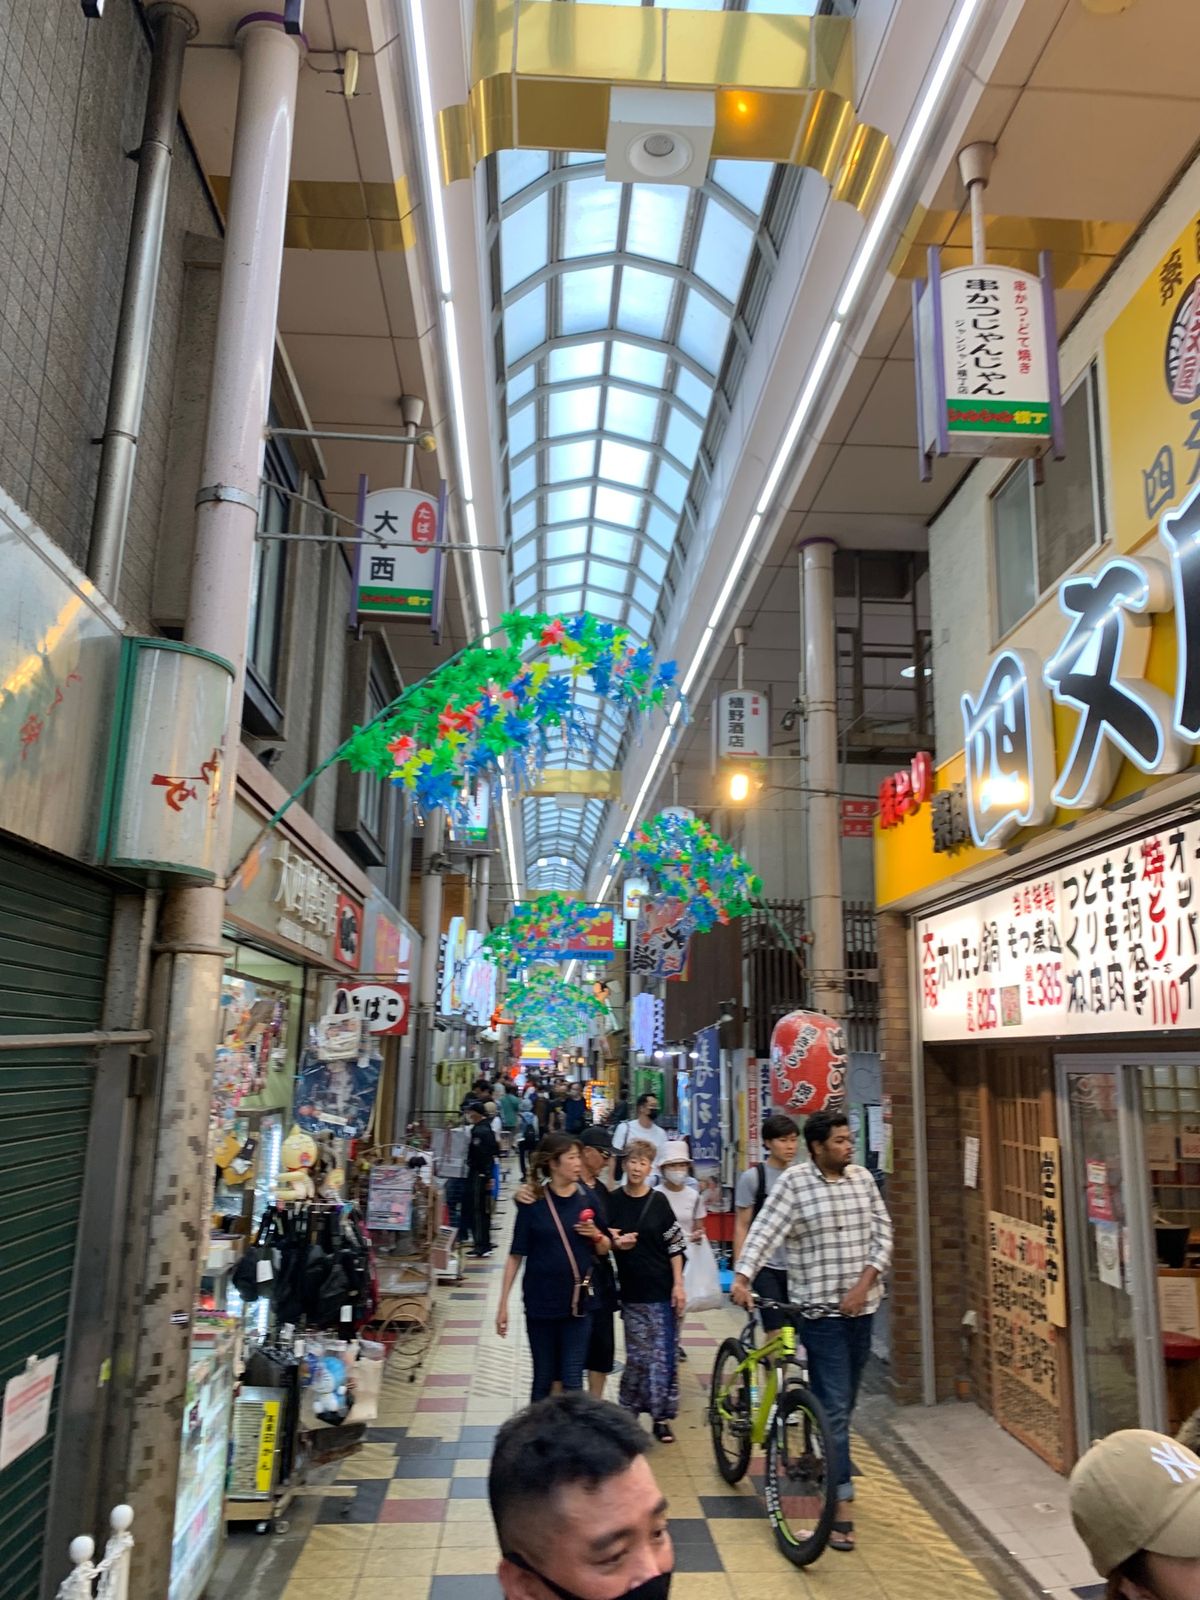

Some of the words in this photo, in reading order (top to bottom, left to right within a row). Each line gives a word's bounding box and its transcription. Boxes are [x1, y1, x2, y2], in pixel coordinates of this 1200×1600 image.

[965, 278, 1007, 396] 串かつじゃんじゃん
[369, 510, 399, 582] 大西
[1062, 876, 1088, 1014] つくね
[1140, 834, 1169, 962] 焼とり
[1151, 979, 1180, 1026] 110
